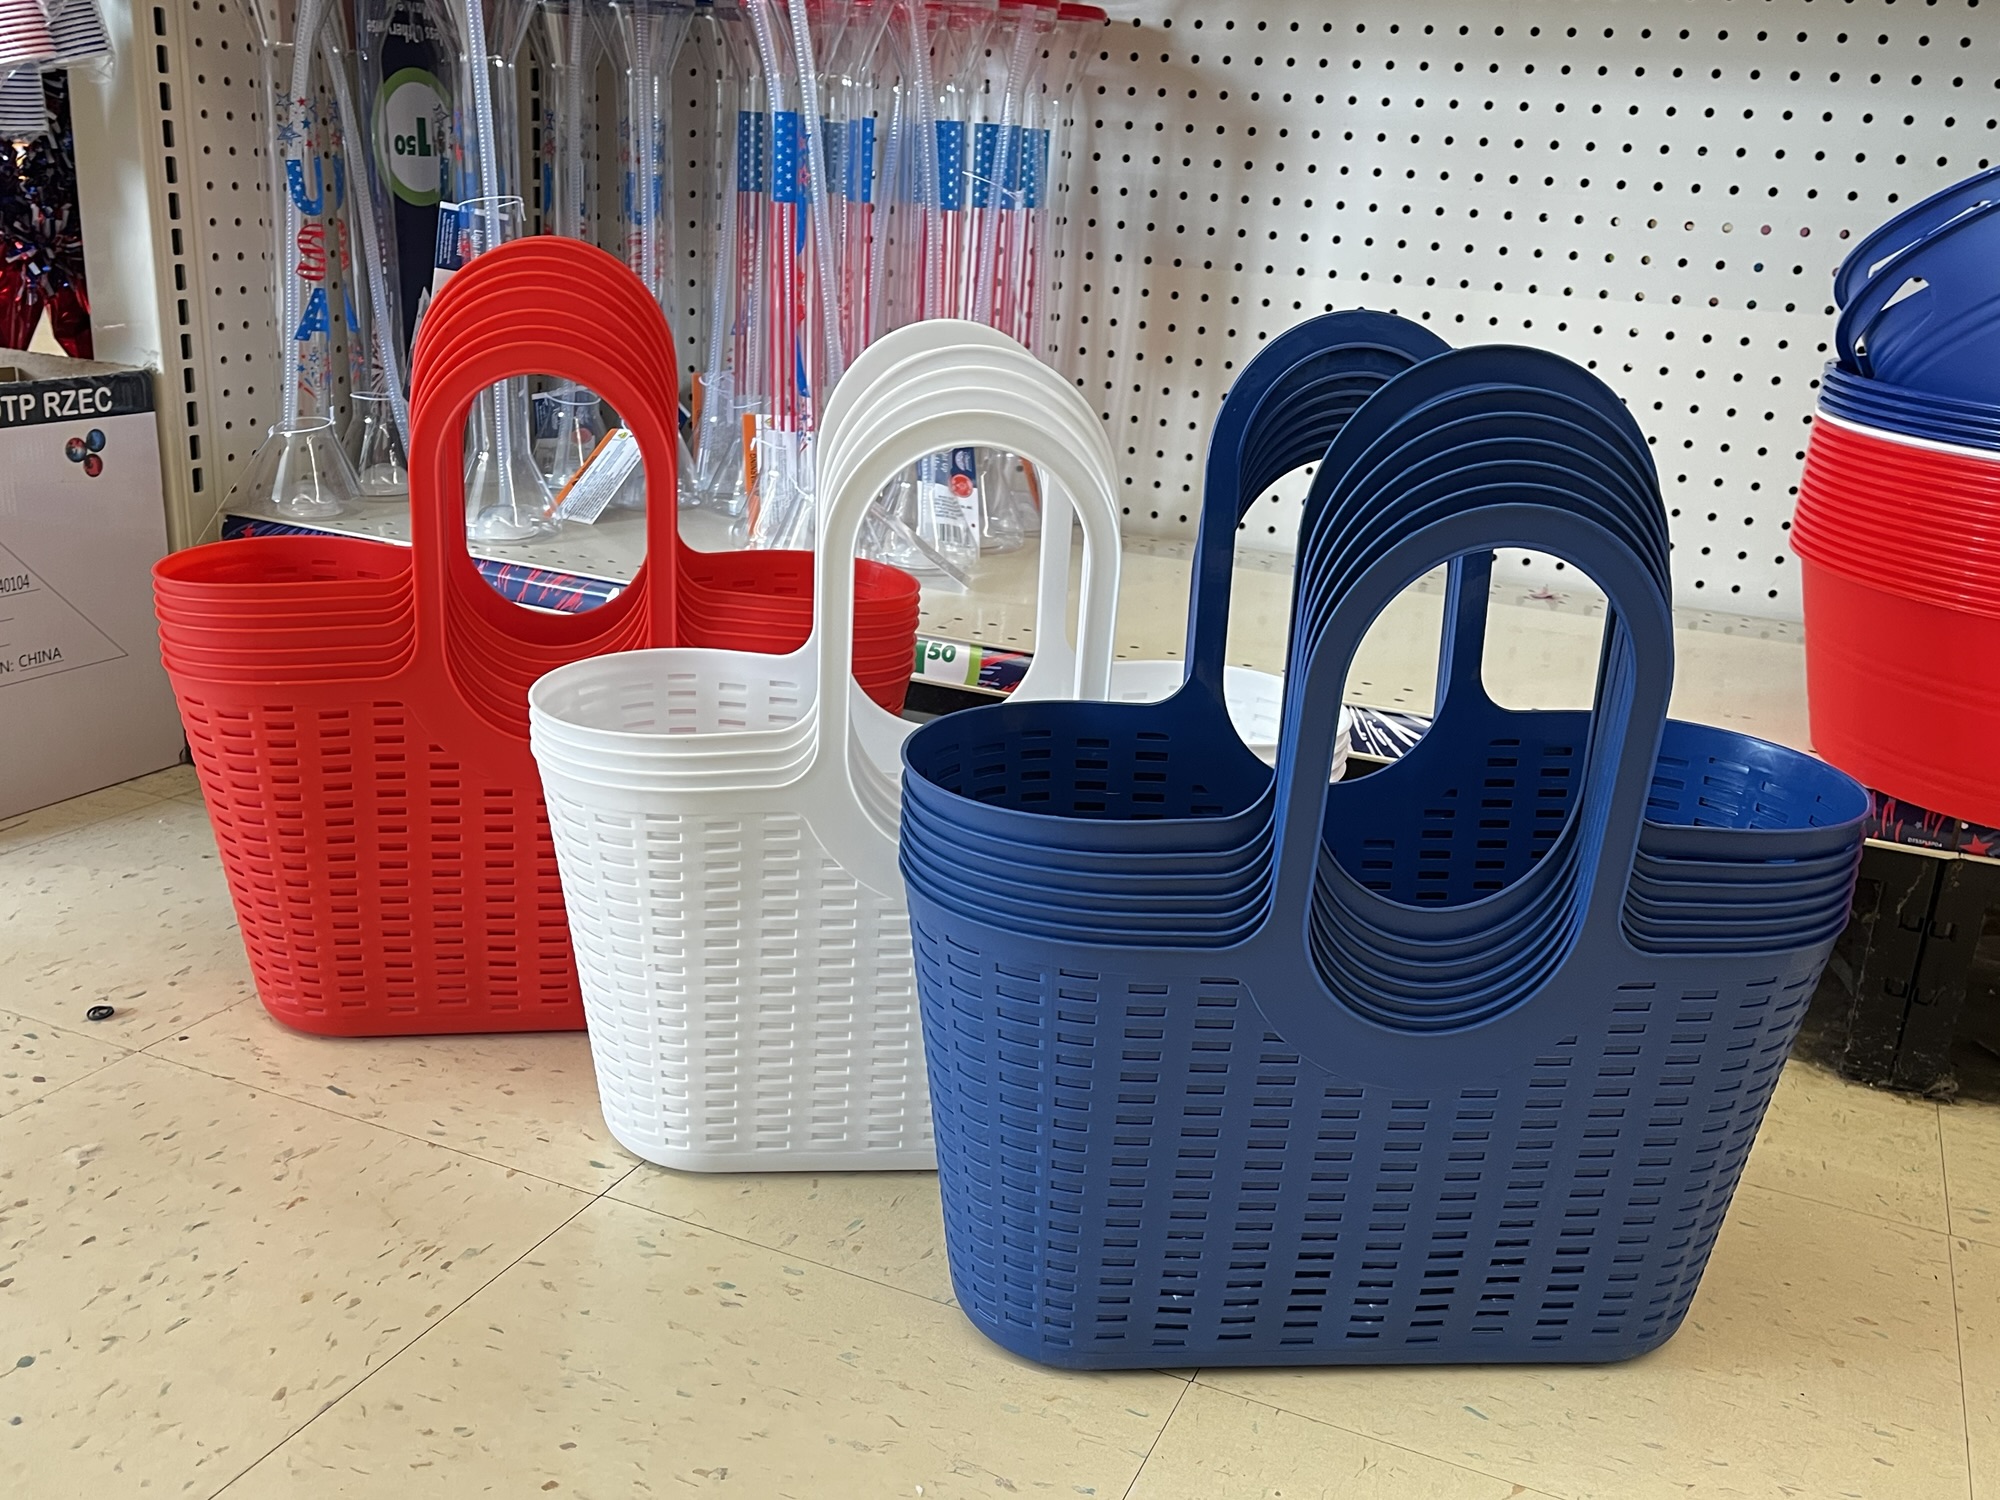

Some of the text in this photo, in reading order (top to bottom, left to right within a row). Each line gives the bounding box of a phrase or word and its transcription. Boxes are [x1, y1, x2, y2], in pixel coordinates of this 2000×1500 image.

[0, 386, 113, 422] TP RZEC
[18, 647, 62, 667] CHINA
